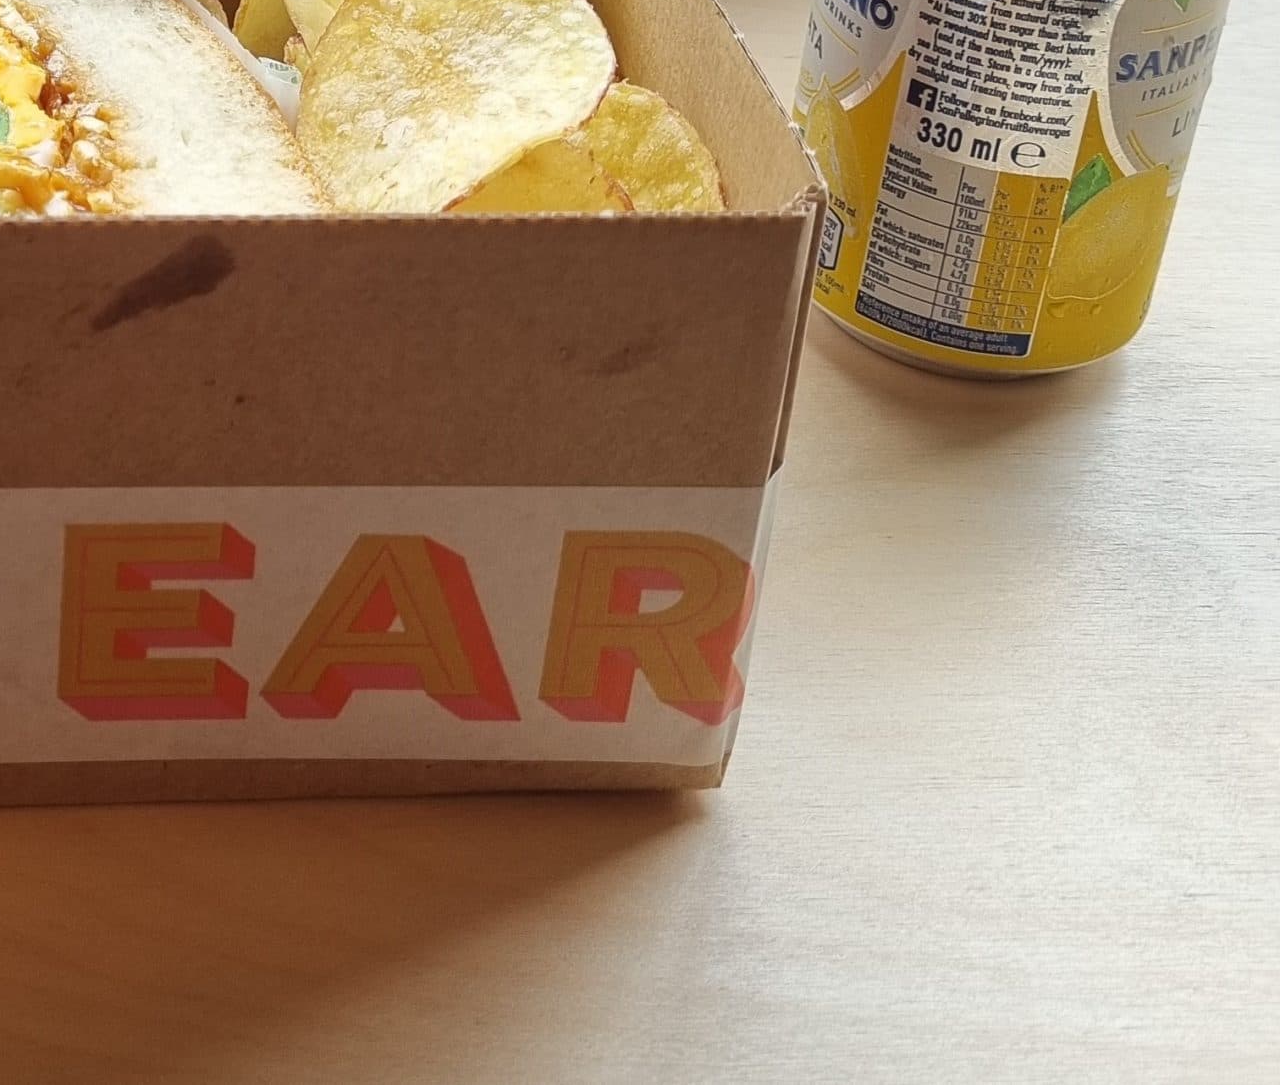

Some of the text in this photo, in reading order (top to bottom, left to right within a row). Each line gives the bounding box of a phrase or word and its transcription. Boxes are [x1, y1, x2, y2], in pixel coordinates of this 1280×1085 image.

[945, 3, 965, 19] least
[967, 11, 987, 27] 30%
[989, 17, 1007, 31] less
[1009, 24, 1035, 38] sugar
[1038, 27, 1059, 40] than
[1062, 30, 1092, 43] similar
[990, 3, 1012, 19] from
[1016, 11, 1049, 25] natural
[919, 11, 1096, 56] sugar sweetened beverages. Best before
[934, 28, 954, 43] (end
[956, 36, 967, 47] of
[969, 39, 983, 52] the
[985, 46, 1015, 62] month,
[908, 46, 1091, 95] dry and odourless place, away from direct
[917, 37, 931, 49] see
[933, 41, 952, 57] base
[955, 49, 965, 61] of
[966, 54, 984, 67] can.
[987, 58, 1011, 73] Store
[1014, 63, 1022, 74] in
[1034, 69, 1059, 82] clean,
[1064, 70, 1083, 83] cool,
[916, 65, 949, 84] sunlight
[952, 75, 968, 89] and
[970, 79, 1008, 101] freezing
[1141, 73, 1199, 102] ITALIAN
[939, 91, 1075, 127] Follow us on facebook.com/
[889, 143, 922, 164] Nutrition
[917, 117, 963, 153] 330
[970, 138, 1002, 163] ml
[884, 166, 938, 196] Typical Values
[886, 155, 933, 181] Information:
[881, 180, 907, 200] Energy
[962, 182, 977, 194] Per
[871, 228, 921, 257] Carbohydrate
[864, 267, 890, 284] Protein
[57, 521, 756, 727] EAR
